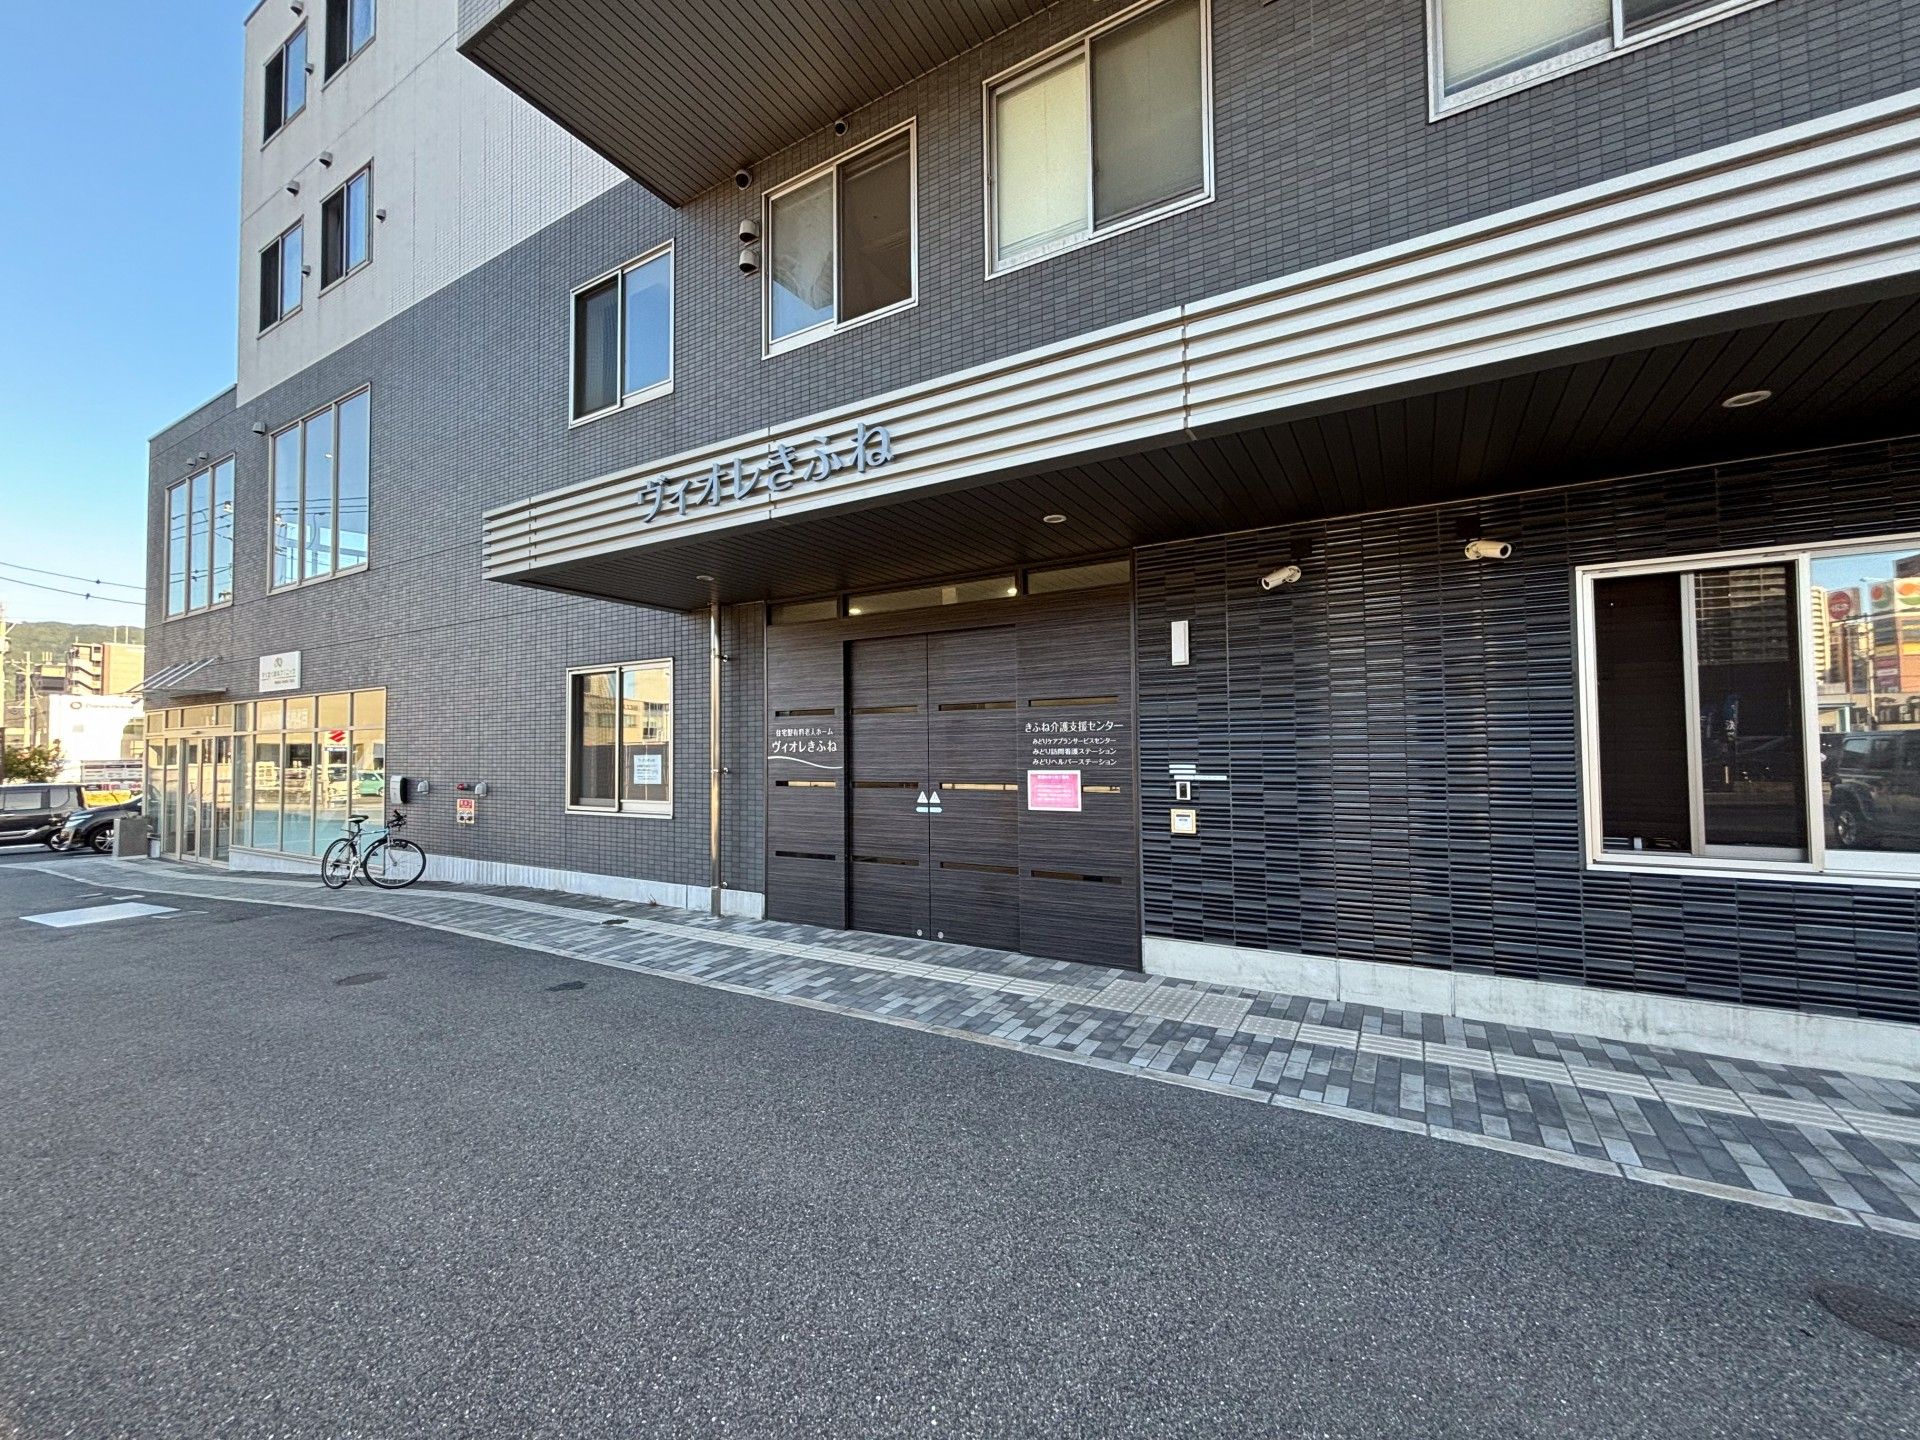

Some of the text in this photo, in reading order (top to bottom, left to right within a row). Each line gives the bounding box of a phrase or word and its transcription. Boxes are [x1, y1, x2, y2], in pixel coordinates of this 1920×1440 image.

[637, 422, 895, 523] ヴィオレきふね
[1025, 720, 1124, 733] きふね介護支援センター
[776, 728, 834, 737] 住宅型有料老人ホーム
[1032, 737, 1117, 745] みどりケアプランサービスセンター
[771, 740, 838, 753] ヴィオレきふね
[1032, 748, 1117, 756] みどり訪問看護ステーション
[1032, 758, 1118, 766] みどりヘルパーステーション
